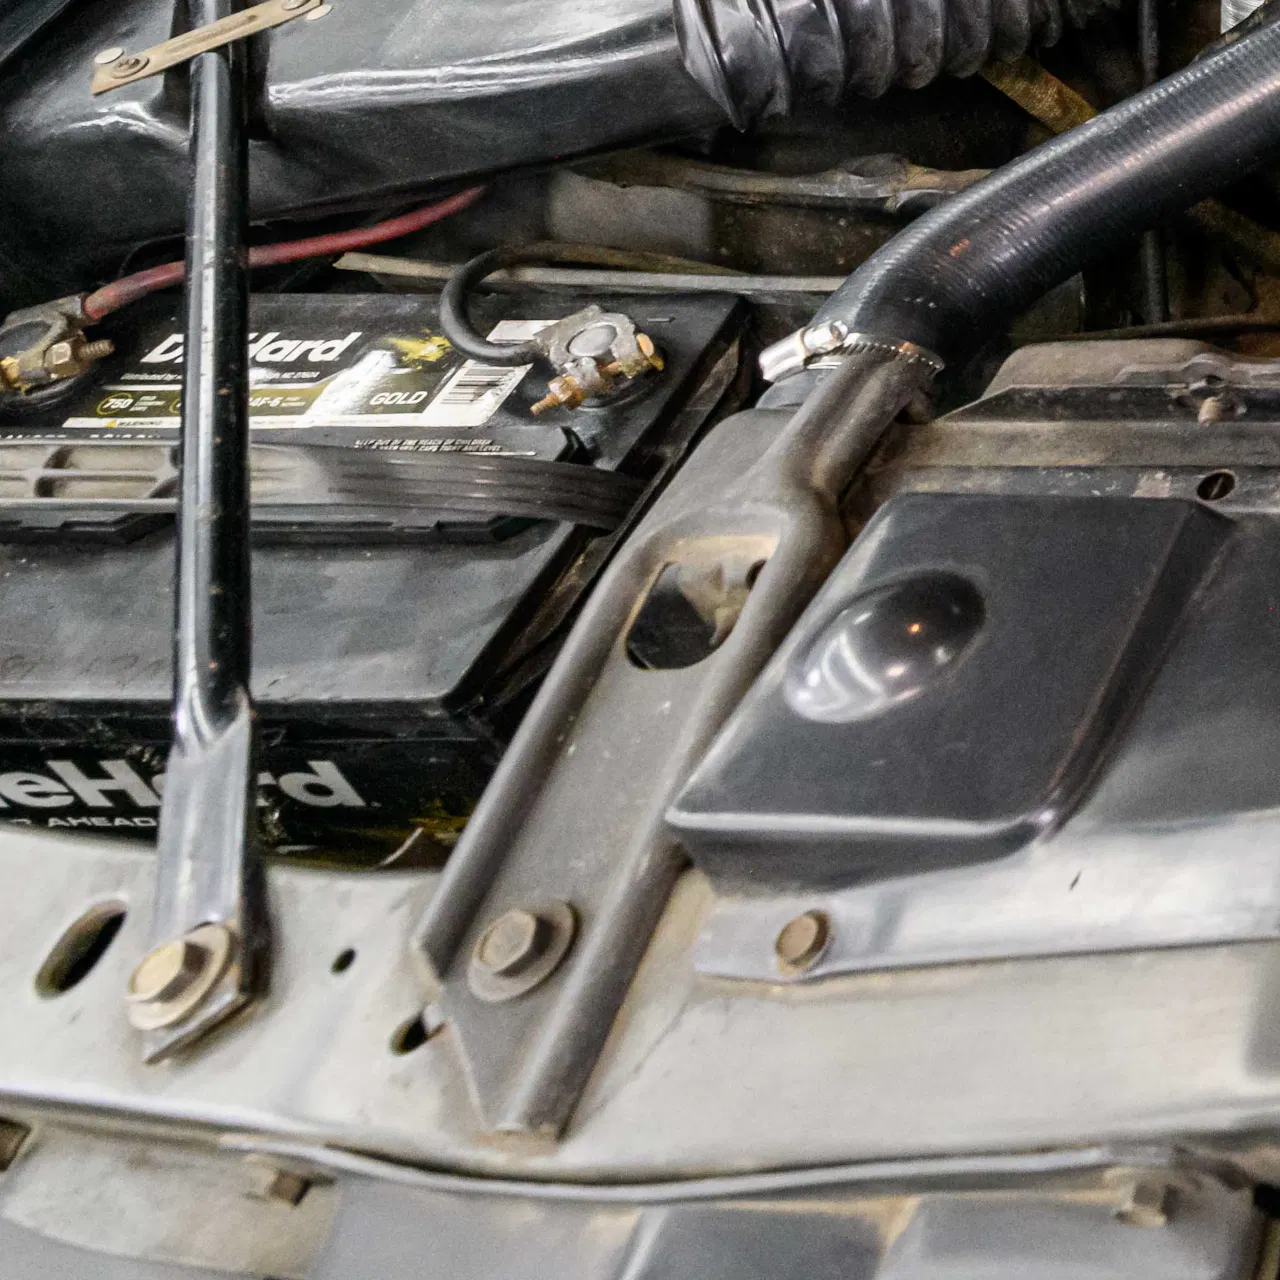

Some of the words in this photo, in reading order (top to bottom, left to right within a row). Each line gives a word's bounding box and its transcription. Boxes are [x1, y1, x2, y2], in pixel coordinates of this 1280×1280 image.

[102, 398, 133, 410] 750
[369, 390, 428, 406] GOLD
[48, 816, 158, 828] AHEAD
